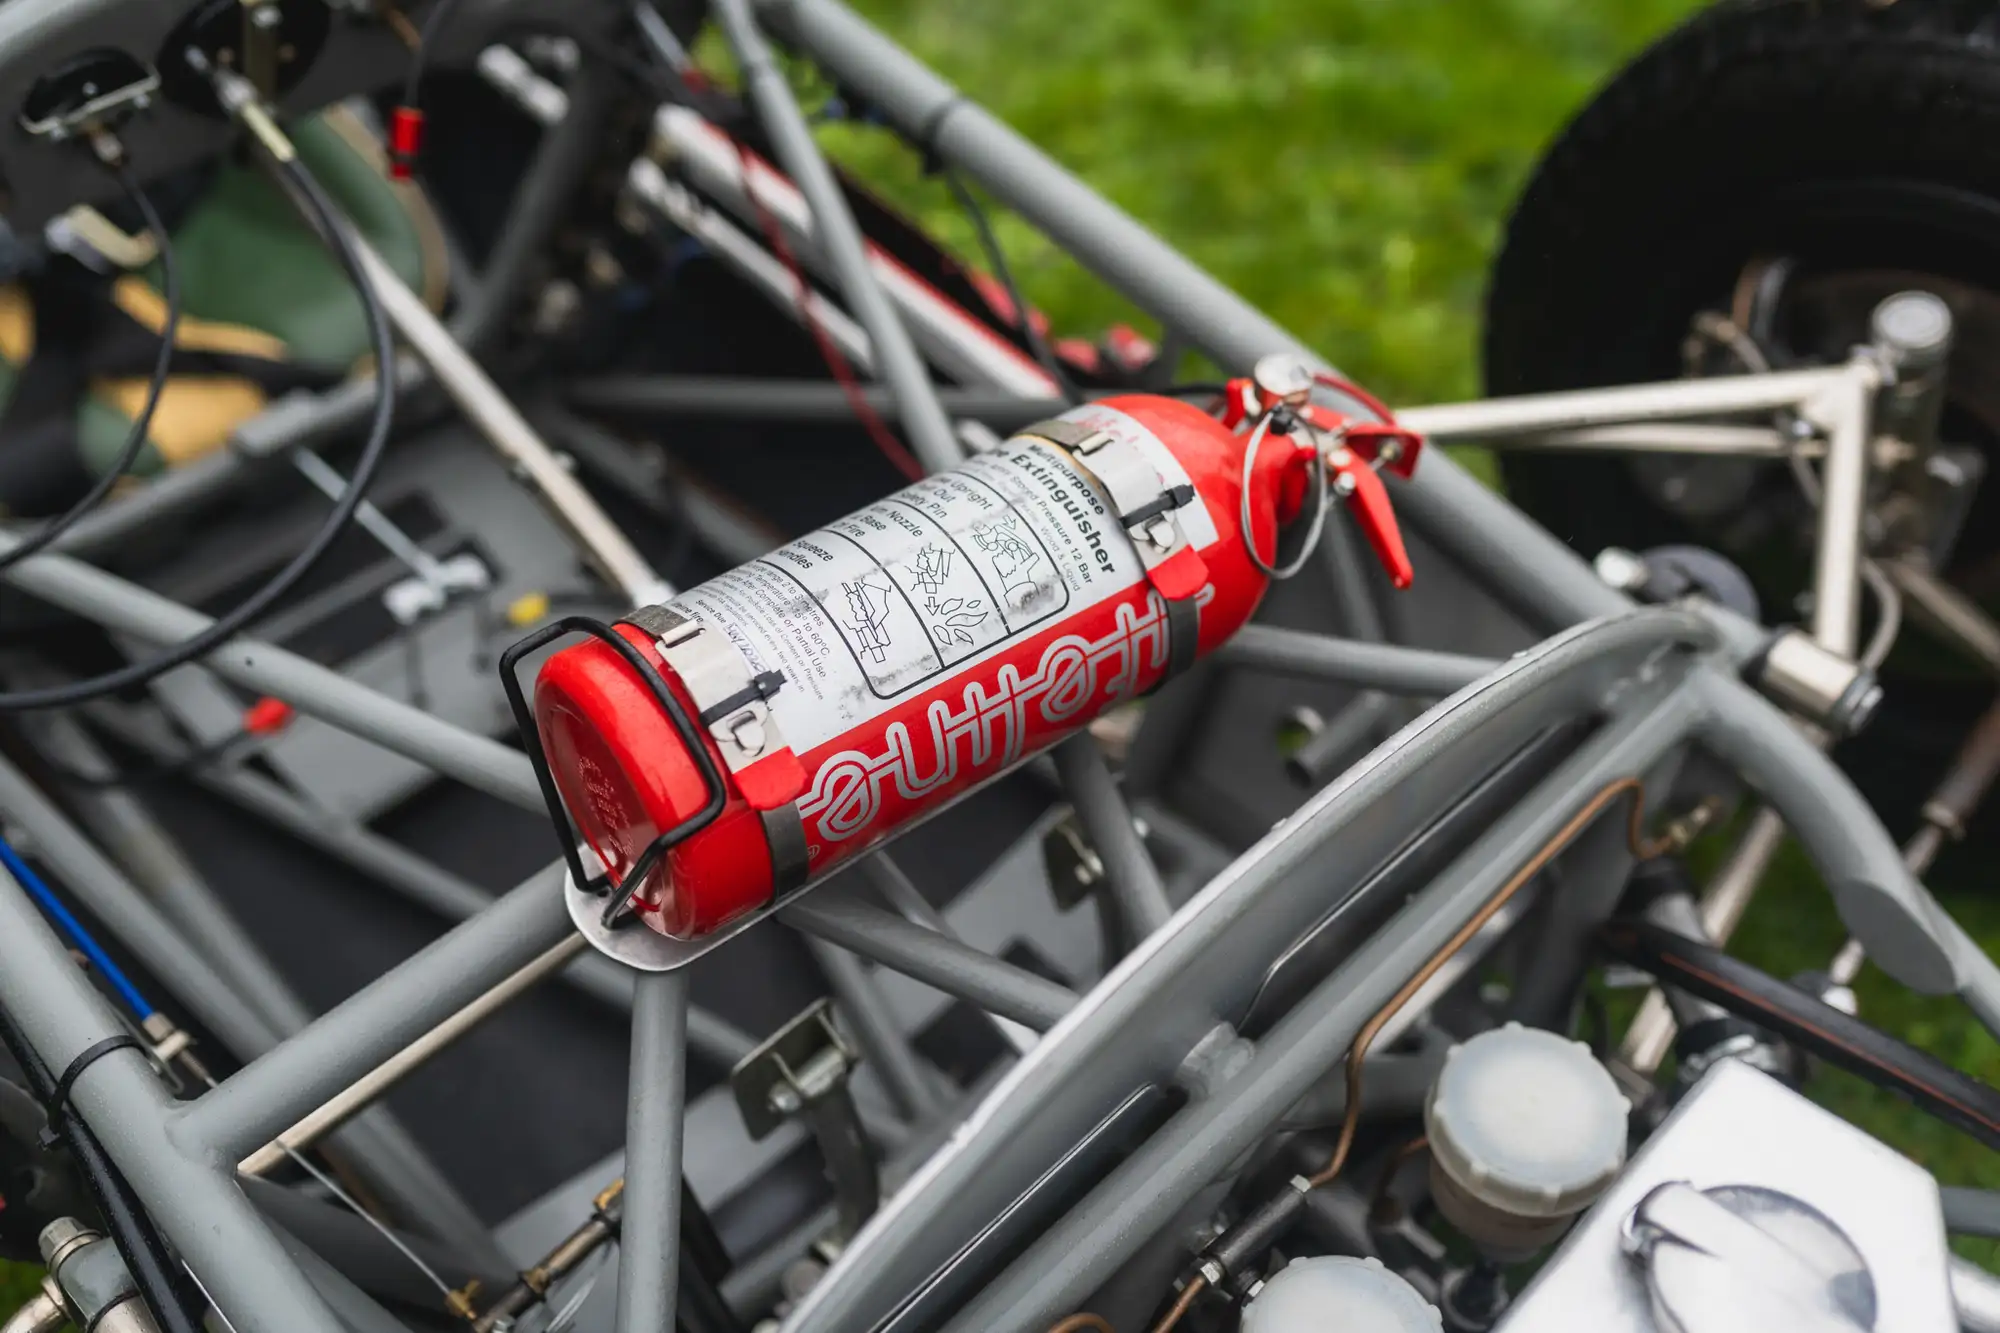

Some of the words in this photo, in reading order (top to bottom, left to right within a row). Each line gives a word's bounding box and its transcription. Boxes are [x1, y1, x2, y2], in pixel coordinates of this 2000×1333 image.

[1026, 441, 1104, 516] Multipurpose
[926, 500, 948, 519] Pin
[932, 485, 956, 505] Out
[947, 479, 993, 511] Upright
[862, 512, 887, 532] Base
[885, 509, 924, 538] Nozzle
[1010, 451, 1116, 576] Extinguisher
[843, 522, 867, 538] Fire
[1036, 498, 1072, 546] Pressure
[1069, 546, 1083, 561] 12
[1076, 560, 1094, 585] Bar
[1038, 525, 1061, 552] Wood
[1061, 560, 1082, 592] Liquid
[752, 574, 791, 606] Temperature
[802, 620, 814, 633] to
[781, 580, 791, 590] 2
[786, 585, 798, 596] to
[793, 592, 803, 601] 3
[695, 598, 717, 614] Service
[712, 611, 727, 624] Due
[755, 587, 786, 619] Complete
[782, 617, 795, 629] or
[790, 626, 816, 657] Partial
[775, 650, 789, 665] two
[779, 632, 801, 660] Content
[802, 666, 825, 701] Pressure
